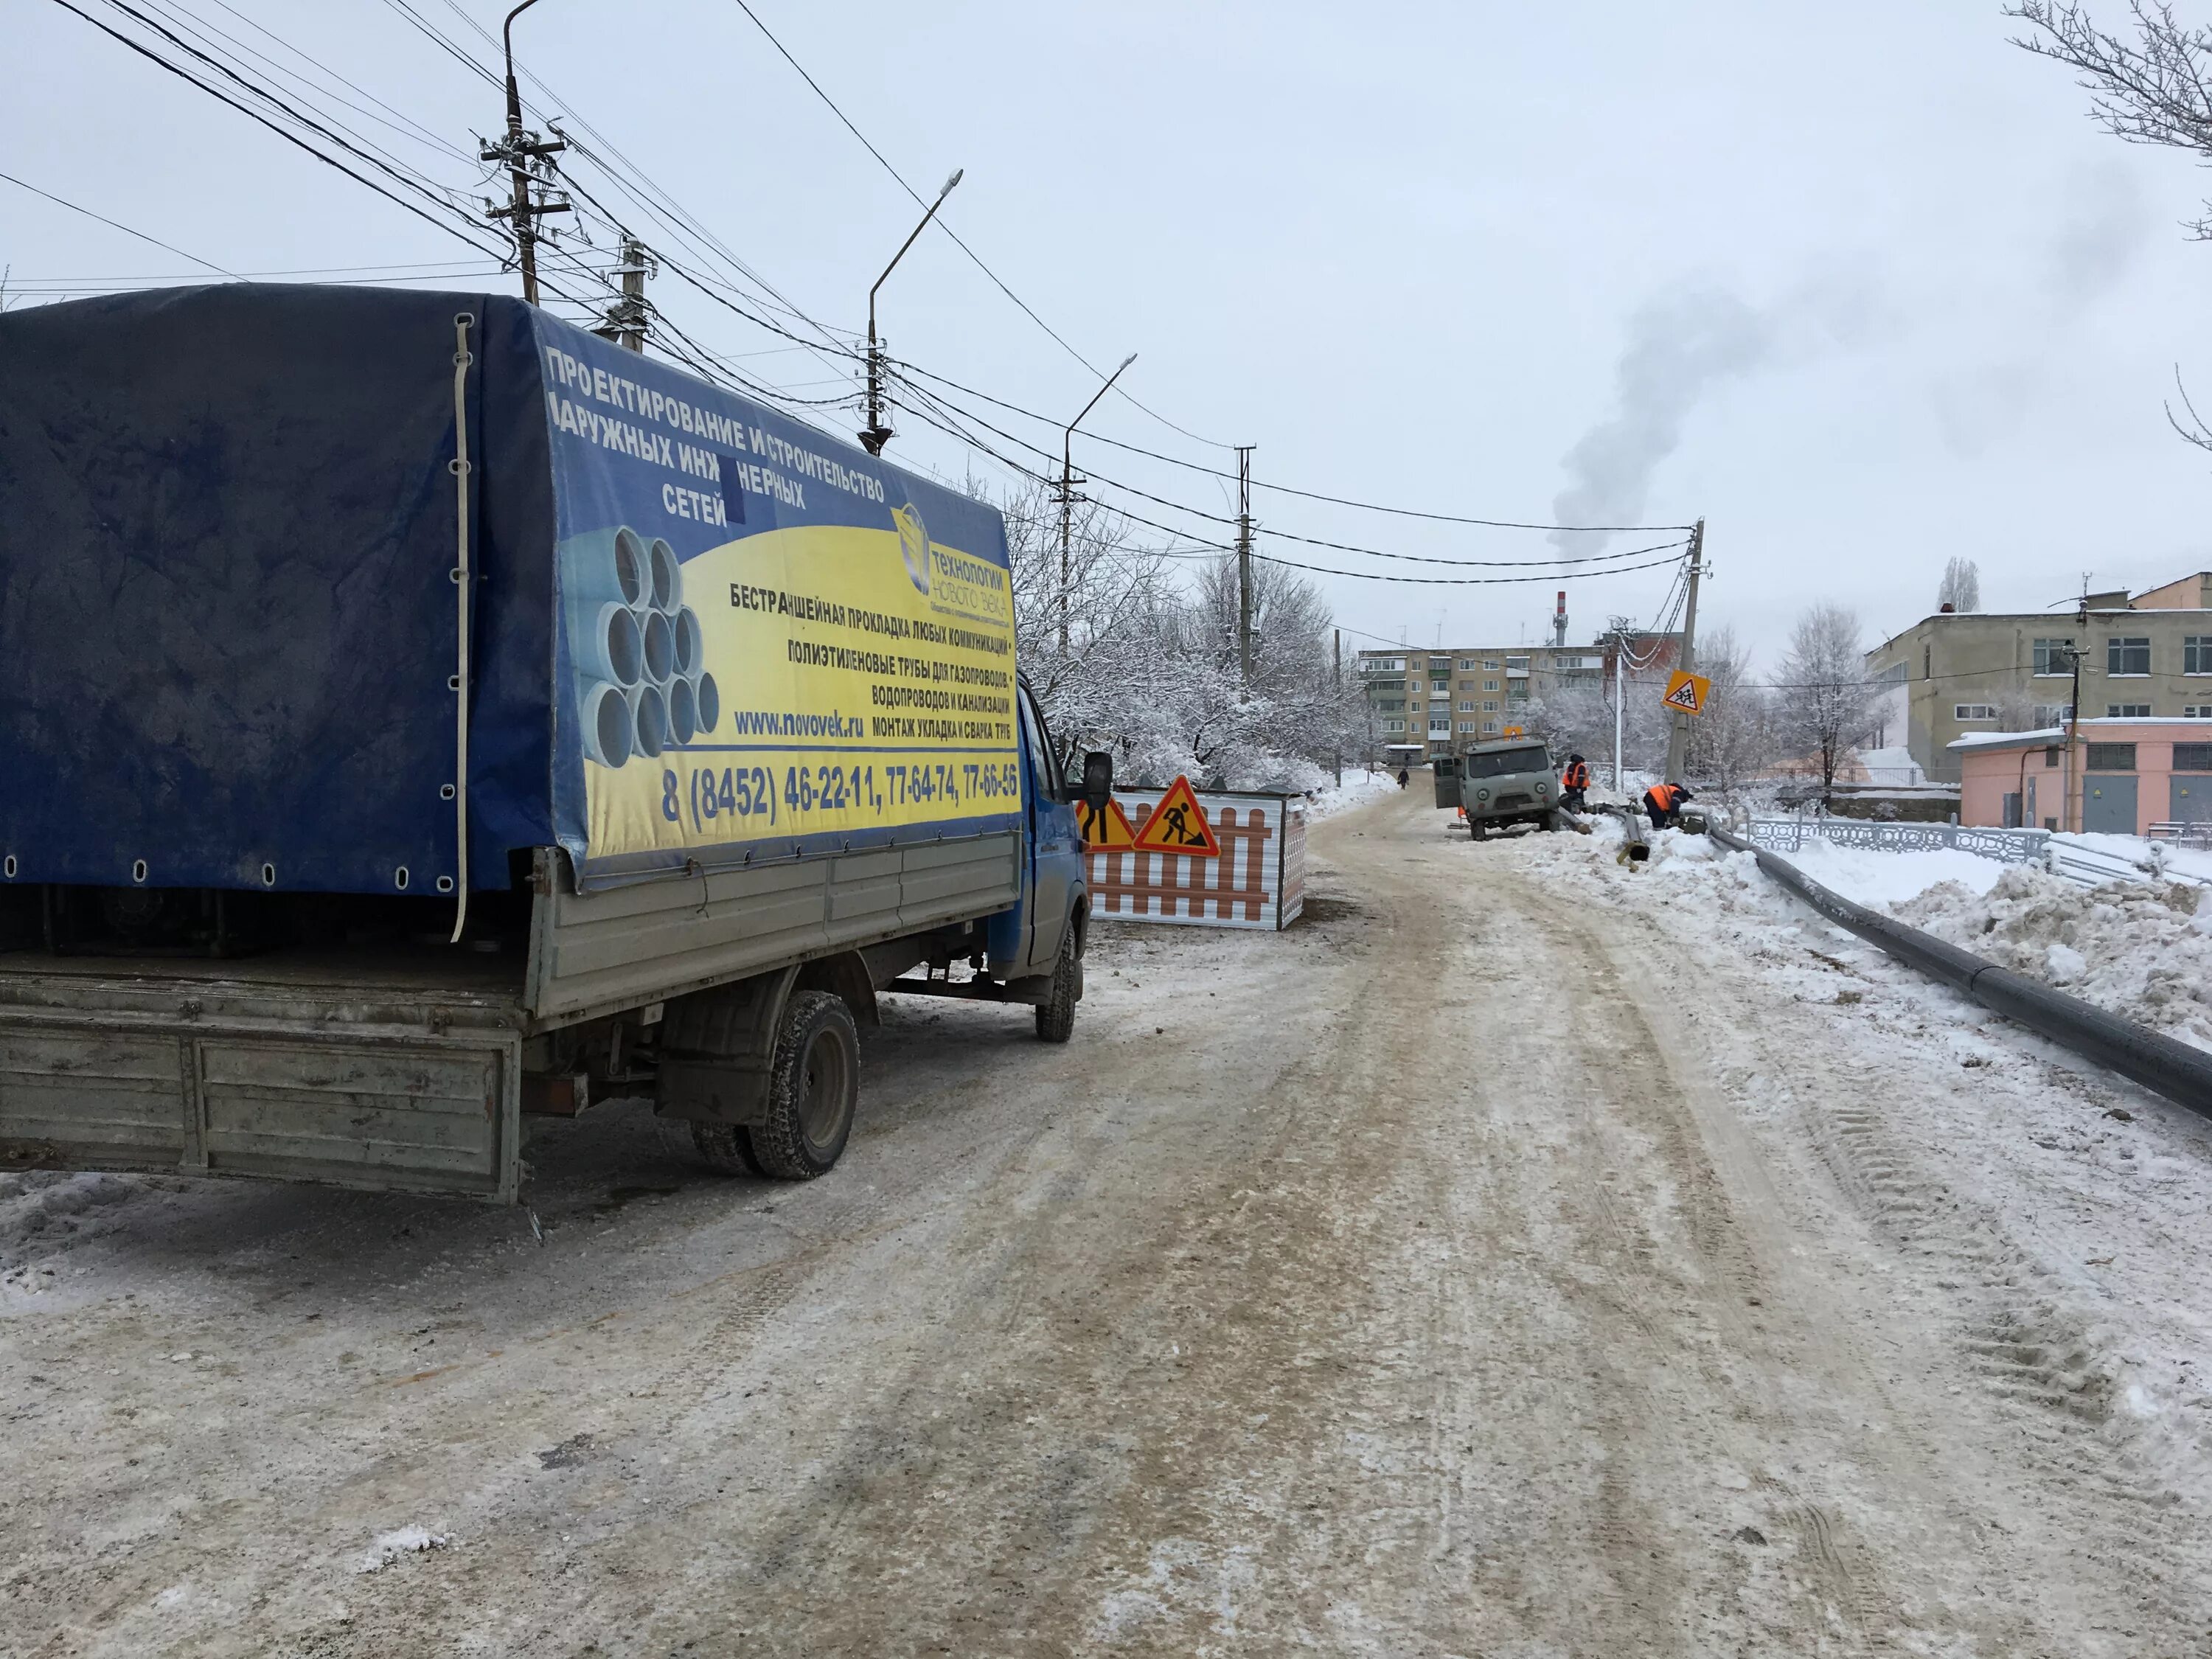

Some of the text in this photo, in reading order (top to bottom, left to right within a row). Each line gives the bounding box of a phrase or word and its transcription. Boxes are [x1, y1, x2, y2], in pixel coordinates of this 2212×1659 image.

[546, 346, 885, 503] ПРОЕКТИРОВАНИЕ И СТРОИТЕЛЬСТВО
[678, 442, 806, 509] ИНЖНЕРНЫХ
[663, 483, 727, 528] СЕТЕЙ
[730, 582, 846, 626] БЕСТРАНШЕЙНАЯ
[848, 608, 911, 640] ПРОКЛАДКА
[912, 620, 947, 644] ЛЮБЫХ
[949, 627, 1008, 657] КОММУНИКАЦИЙ
[788, 639, 896, 675] ПОЛИЭТИЛЕНОВЫЕ
[897, 657, 931, 678] ТРУБЫ
[932, 661, 949, 684] ДЛЯ
[734, 709, 863, 737] www.novovek.ru
[872, 685, 1010, 716] ВОДОПРОВОДОВ И КАНАЛИЗАЦИИ
[872, 717, 915, 737] МОНТАЖ
[917, 719, 958, 742] УКЛАДКА
[958, 721, 964, 738] И
[964, 722, 993, 739] СВАРКА
[662, 763, 1018, 833] 8 (8452) 46-22-11, 77-64-74, 77-66-56
